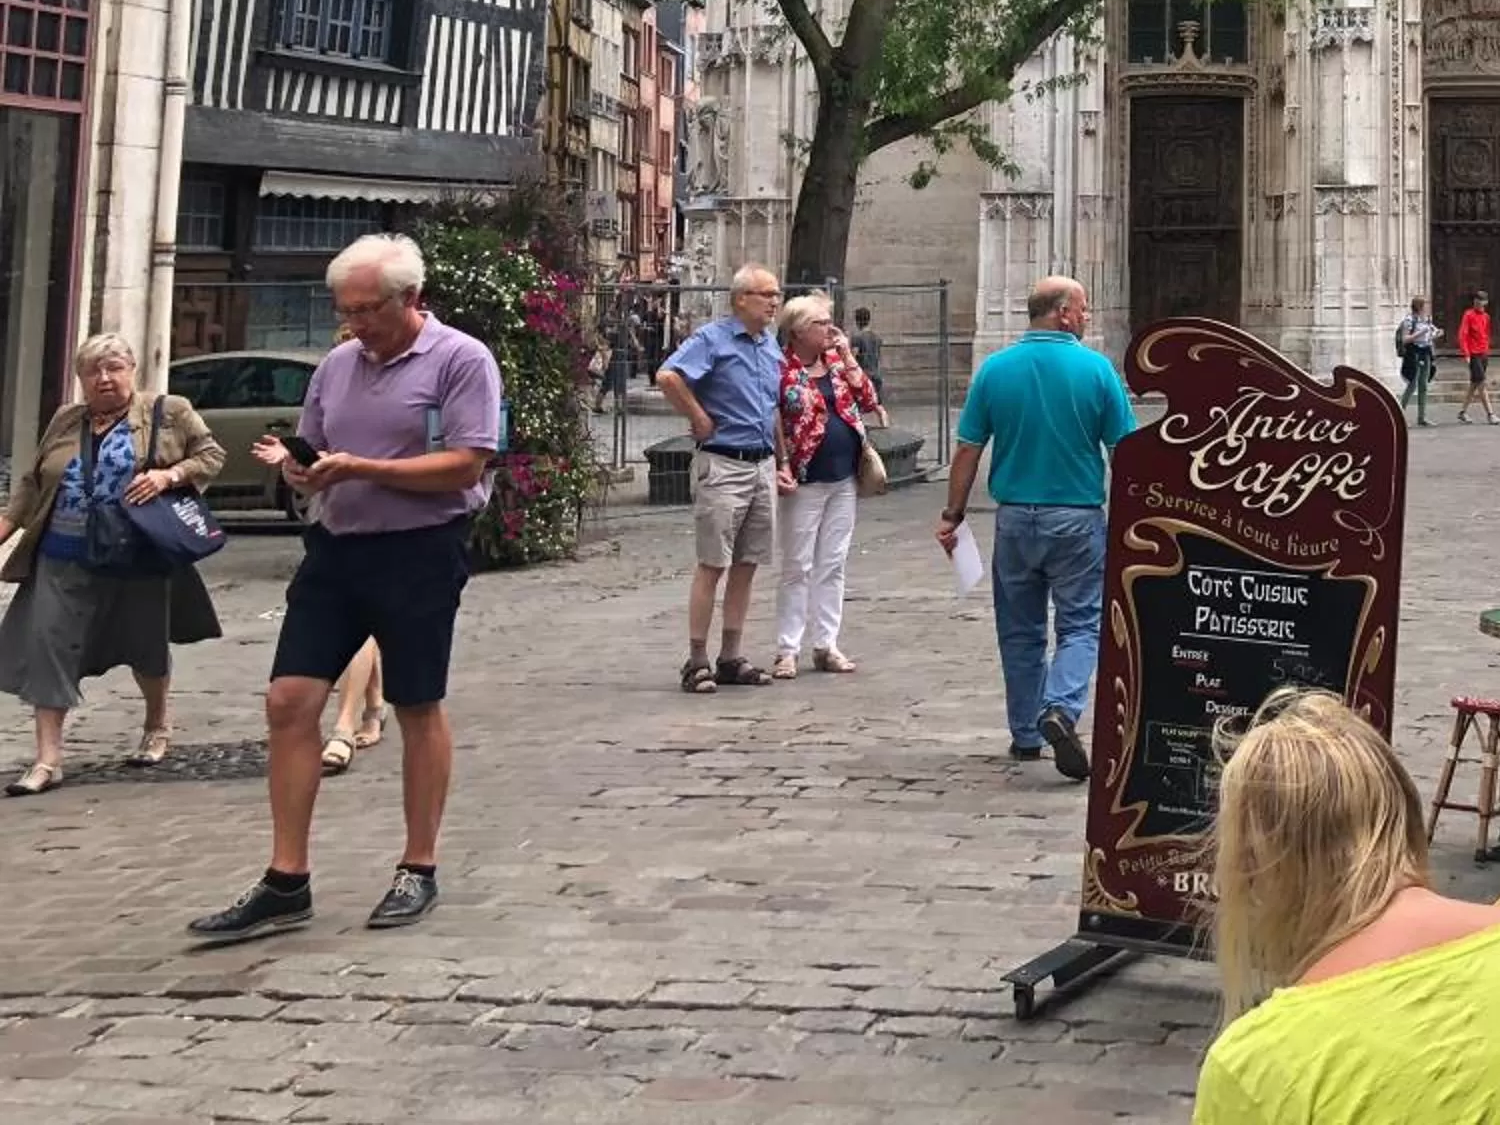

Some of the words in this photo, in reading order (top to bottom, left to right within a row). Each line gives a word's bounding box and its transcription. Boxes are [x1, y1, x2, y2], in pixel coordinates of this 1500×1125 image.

[1160, 384, 1361, 448] Antico
[1189, 434, 1372, 518] Caffé
[1145, 482, 1218, 521] Service
[1237, 519, 1281, 551] toute
